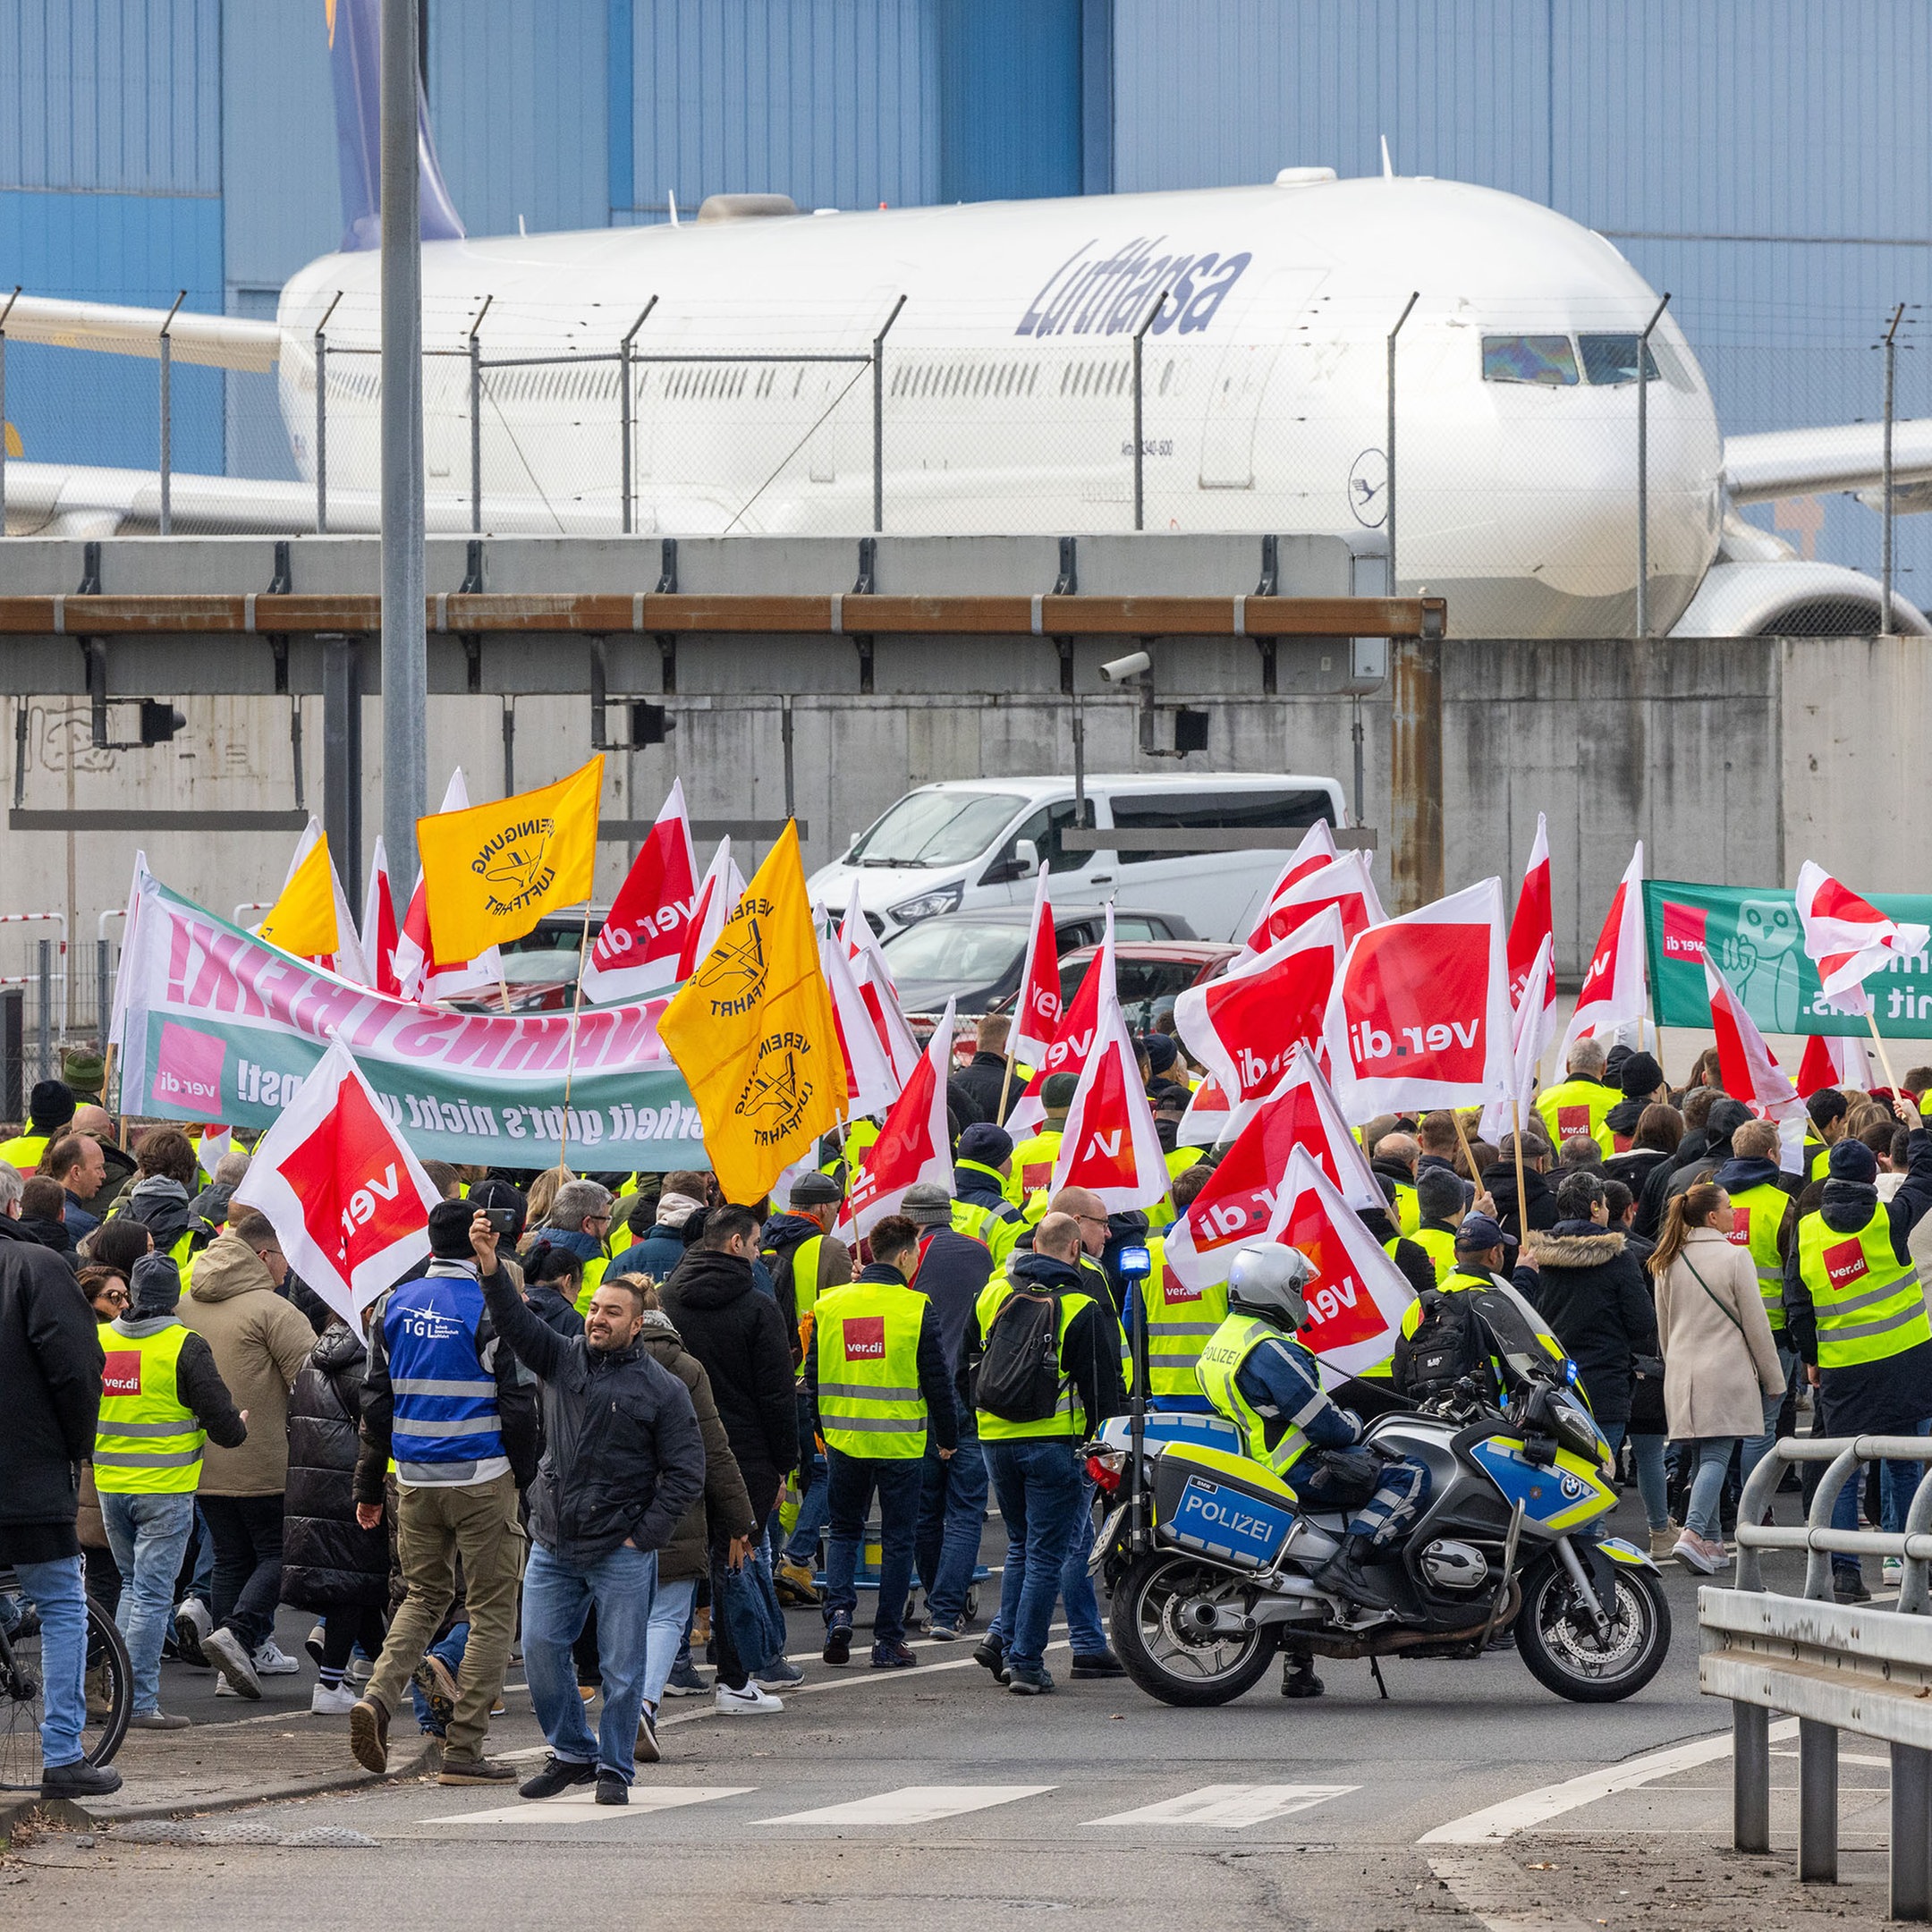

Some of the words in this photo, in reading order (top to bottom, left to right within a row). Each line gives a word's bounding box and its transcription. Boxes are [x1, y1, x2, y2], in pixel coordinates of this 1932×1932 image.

[1014, 235, 1252, 339] Lufthansa
[1561, 1125, 1589, 1134] ver.di
[1830, 1258, 1865, 1278] ver.di
[403, 1318, 434, 1339] TGL
[847, 1342, 883, 1353] ver.di
[1203, 1346, 1241, 1366] POLIZEI
[104, 1377, 138, 1390] ver.di
[1197, 1480, 1212, 1490] BMW
[1185, 1495, 1274, 1543] POLIZEI
